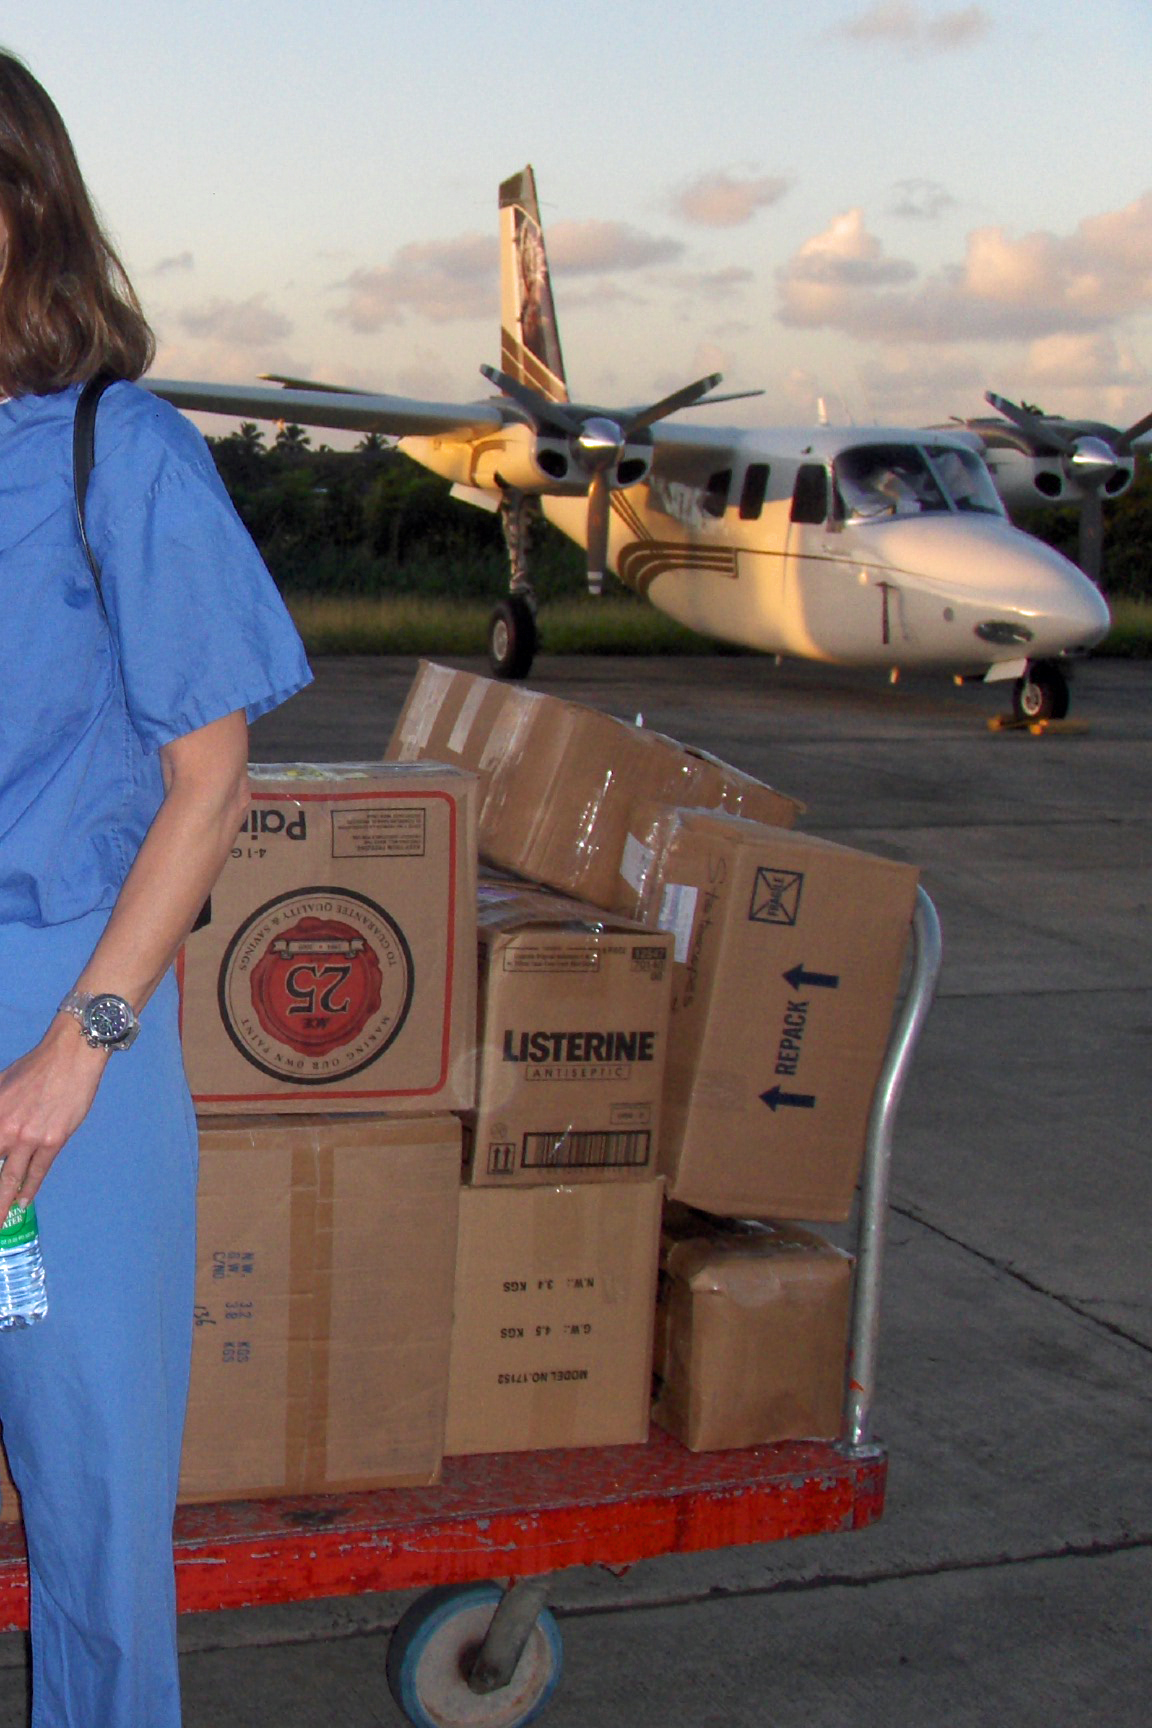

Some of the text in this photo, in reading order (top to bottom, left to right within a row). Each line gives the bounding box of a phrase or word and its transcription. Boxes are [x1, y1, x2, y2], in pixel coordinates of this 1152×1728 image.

[231, 848, 267, 859] 4-1 G
[240, 902, 397, 971] TO GUARANTEE QUALITY & SAVINGS
[285, 964, 352, 1015] 25
[241, 1016, 390, 1070] MAKING OUR OWN PAINT
[503, 1030, 655, 1062] LISTERINE
[775, 1000, 810, 1077] REPACK
[532, 1066, 624, 1078] ANTISEPTIC
[2, 1215, 23, 1229] ATER
[503, 1281, 527, 1293] KGS
[500, 1327, 524, 1339] KGS
[535, 1325, 551, 1337] 4.5
[222, 1342, 236, 1363] KGS
[236, 1341, 251, 1363] KGS
[550, 1368, 589, 1381] MODEL
